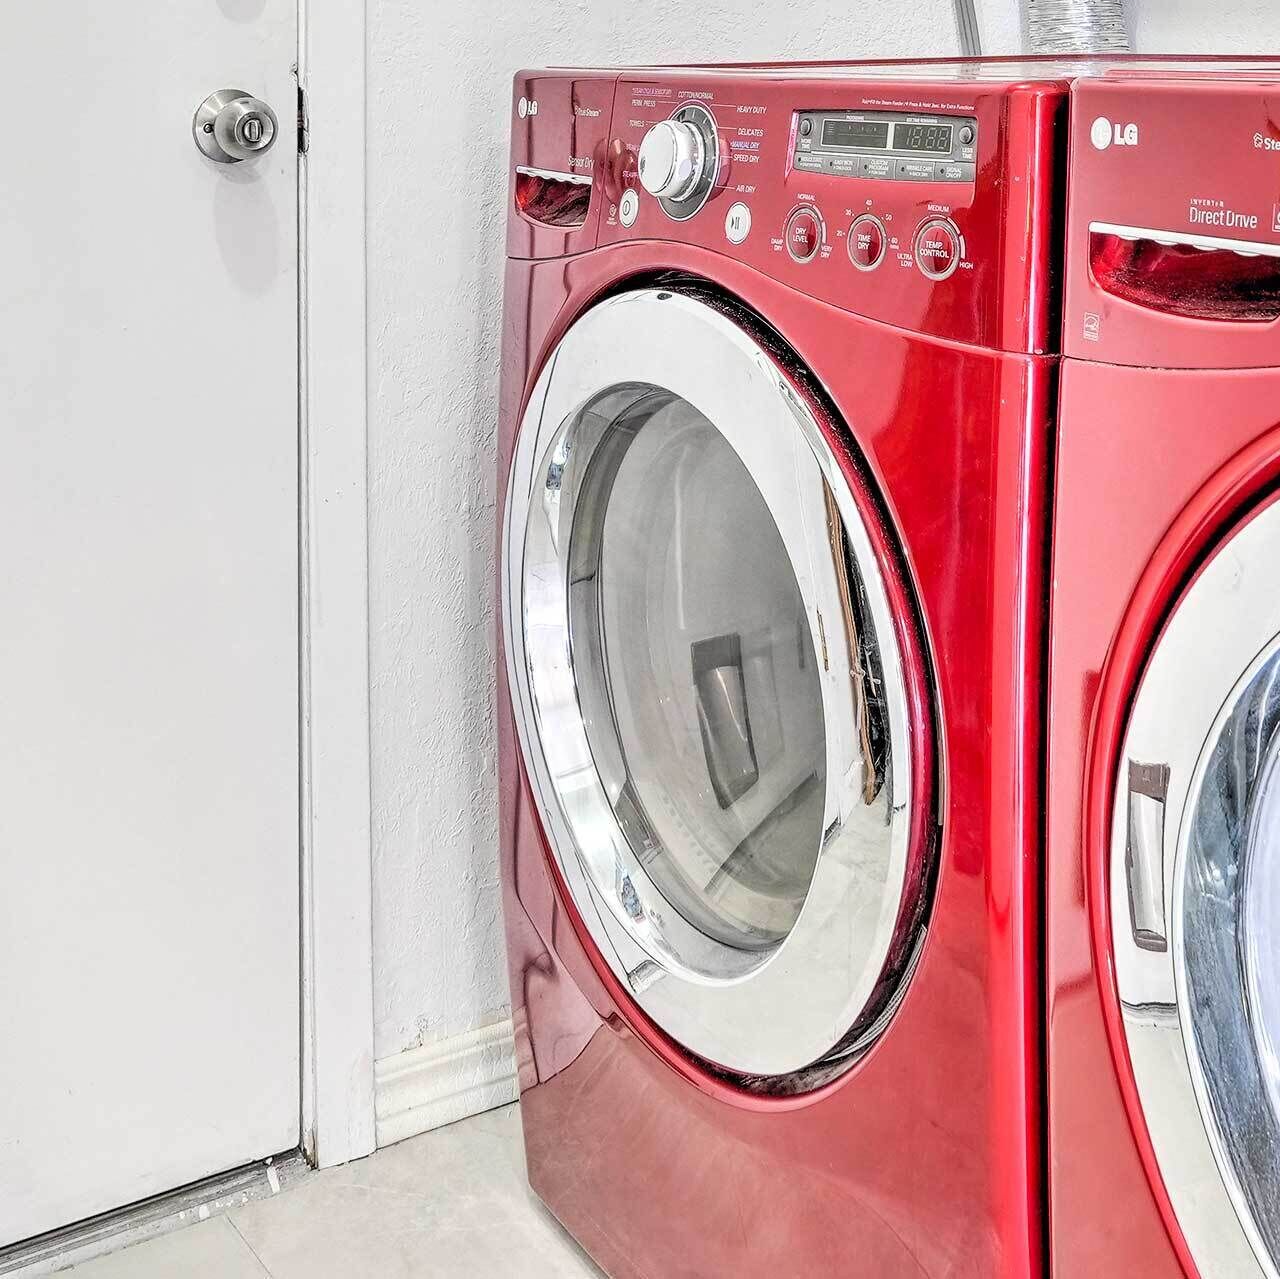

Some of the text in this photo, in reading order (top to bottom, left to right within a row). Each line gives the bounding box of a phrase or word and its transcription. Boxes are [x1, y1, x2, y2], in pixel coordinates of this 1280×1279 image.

[527, 101, 538, 115] LG
[738, 128, 763, 136] DELICATES
[1114, 124, 1138, 145] LG
[733, 154, 759, 163] SPEED DRY
[797, 193, 815, 201] NORMAL
[927, 204, 950, 213] MEDIUM
[1189, 207, 1258, 229] Direct Drive
[795, 227, 806, 235] DRY
[793, 234, 808, 243] LEVEL
[857, 242, 870, 250] DRY
[820, 251, 830, 259] DRY
[897, 253, 913, 261] ULTRA
[920, 248, 950, 259] CONTROL
[900, 260, 913, 268] LOW
[959, 261, 974, 269] HIGH
